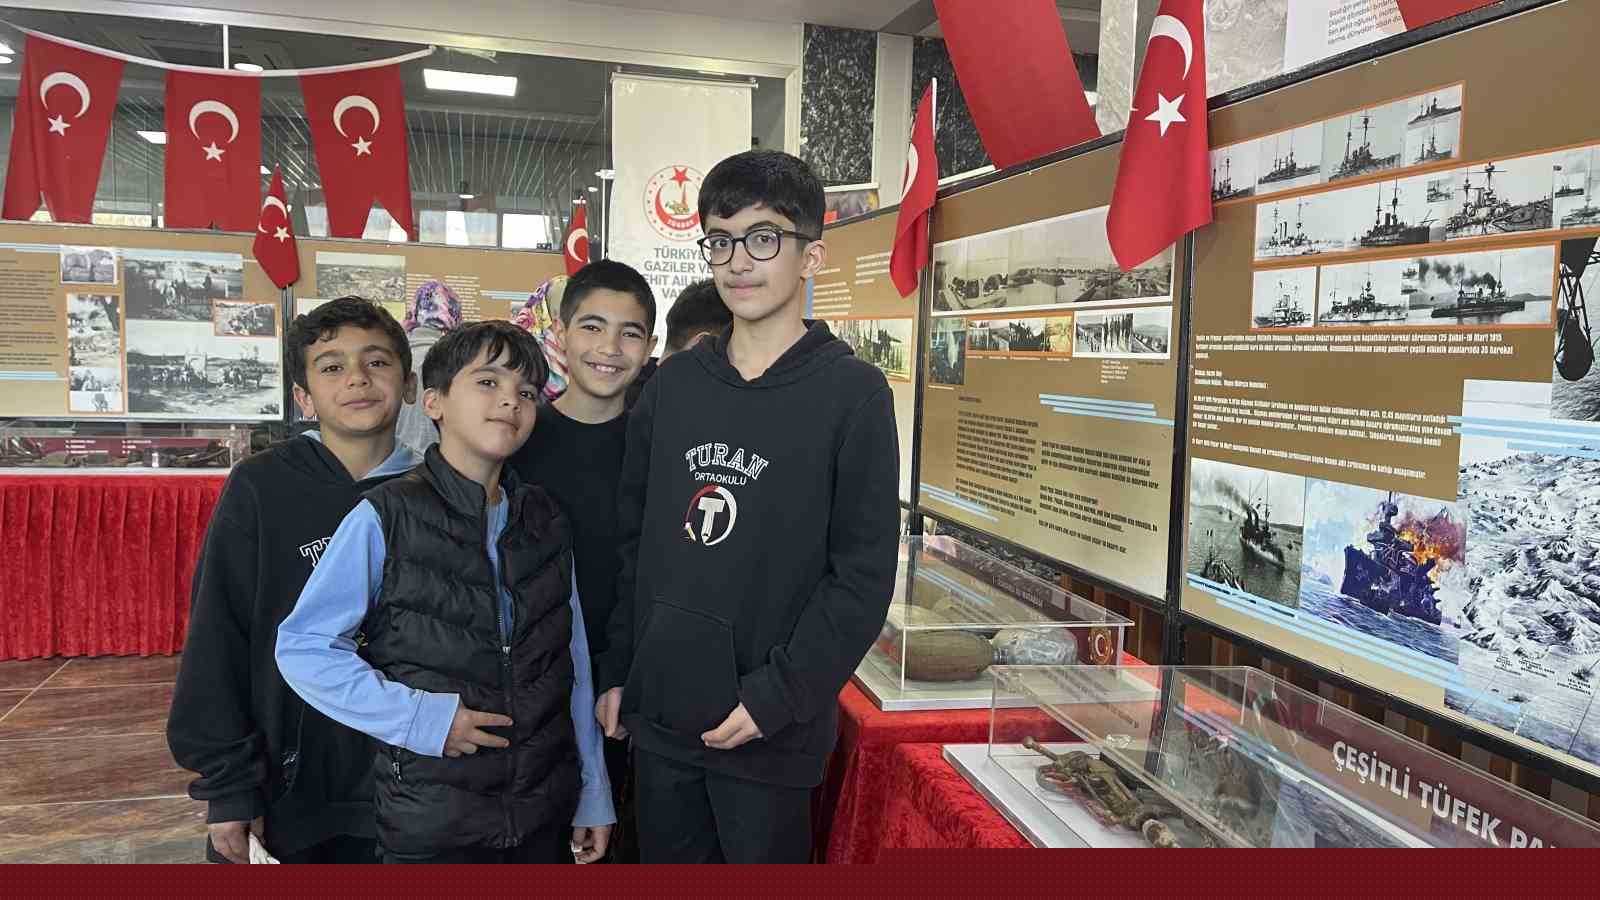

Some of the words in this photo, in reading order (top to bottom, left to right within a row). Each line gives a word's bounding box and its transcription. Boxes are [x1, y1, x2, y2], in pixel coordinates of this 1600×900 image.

[644, 260, 695, 273] GAZİLER
[643, 274, 670, 286] EHİT
[685, 443, 769, 480] TURAN
[694, 471, 747, 486] ORTAOKULU
[300, 537, 331, 568] T
[1332, 740, 1410, 800] ÇEŞİTLİ
[1418, 781, 1501, 846] TÜFEK
